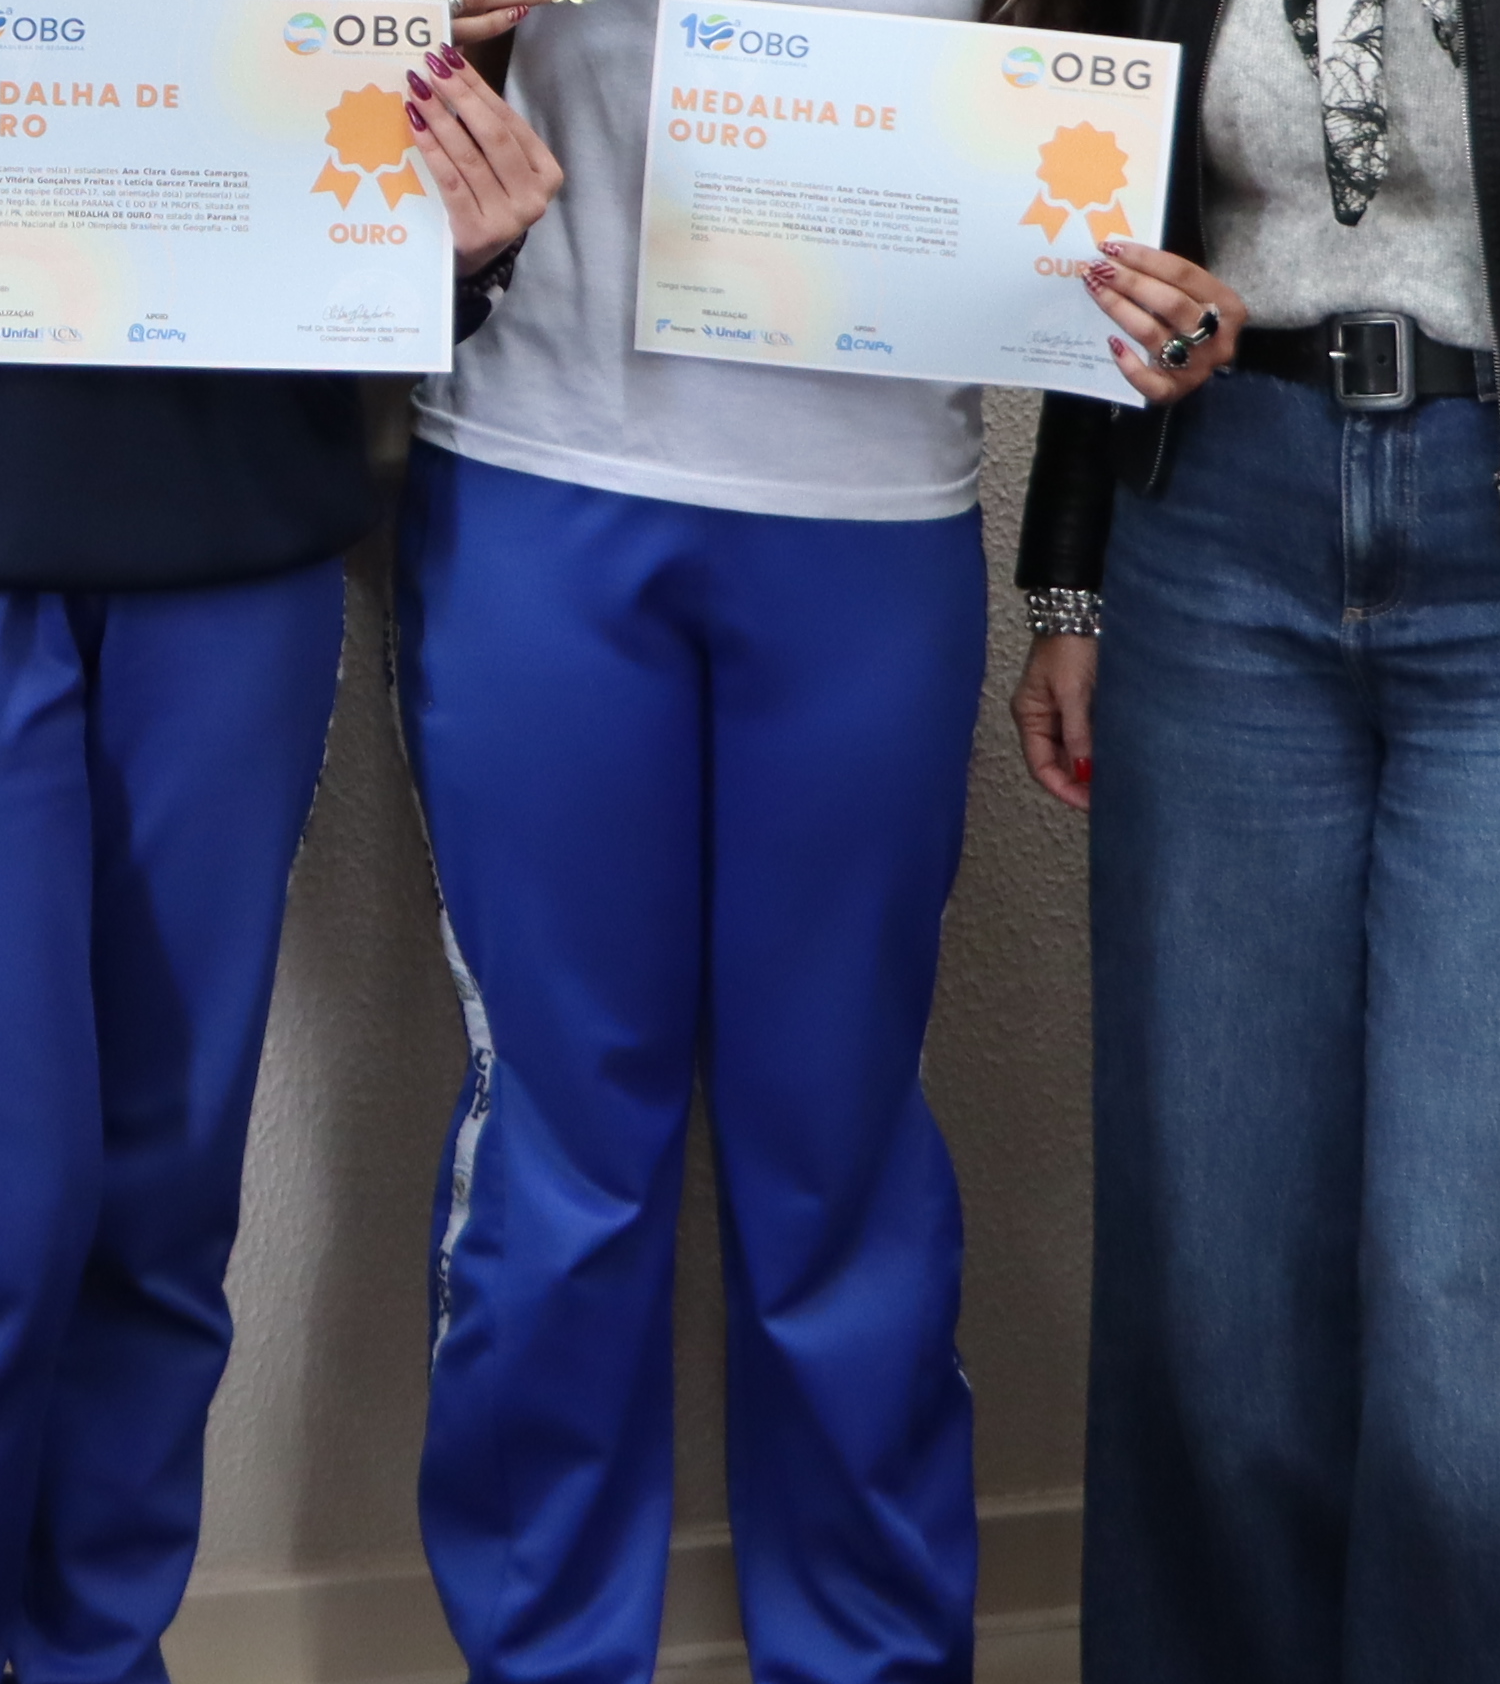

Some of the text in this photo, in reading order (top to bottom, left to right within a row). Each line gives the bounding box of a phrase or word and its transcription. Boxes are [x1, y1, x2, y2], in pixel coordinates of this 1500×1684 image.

[12, 16, 85, 42] OBG
[333, 14, 431, 47] OBG
[738, 29, 810, 59] OBG
[1050, 50, 1153, 91] OBG
[136, 83, 179, 109] DE
[670, 85, 897, 131] MEDALHA DE
[667, 117, 767, 150] OURO
[328, 222, 407, 244] OURO
[1033, 255, 1092, 280] OUR
[145, 328, 186, 343] CNPq
[853, 338, 893, 354] CNPq
